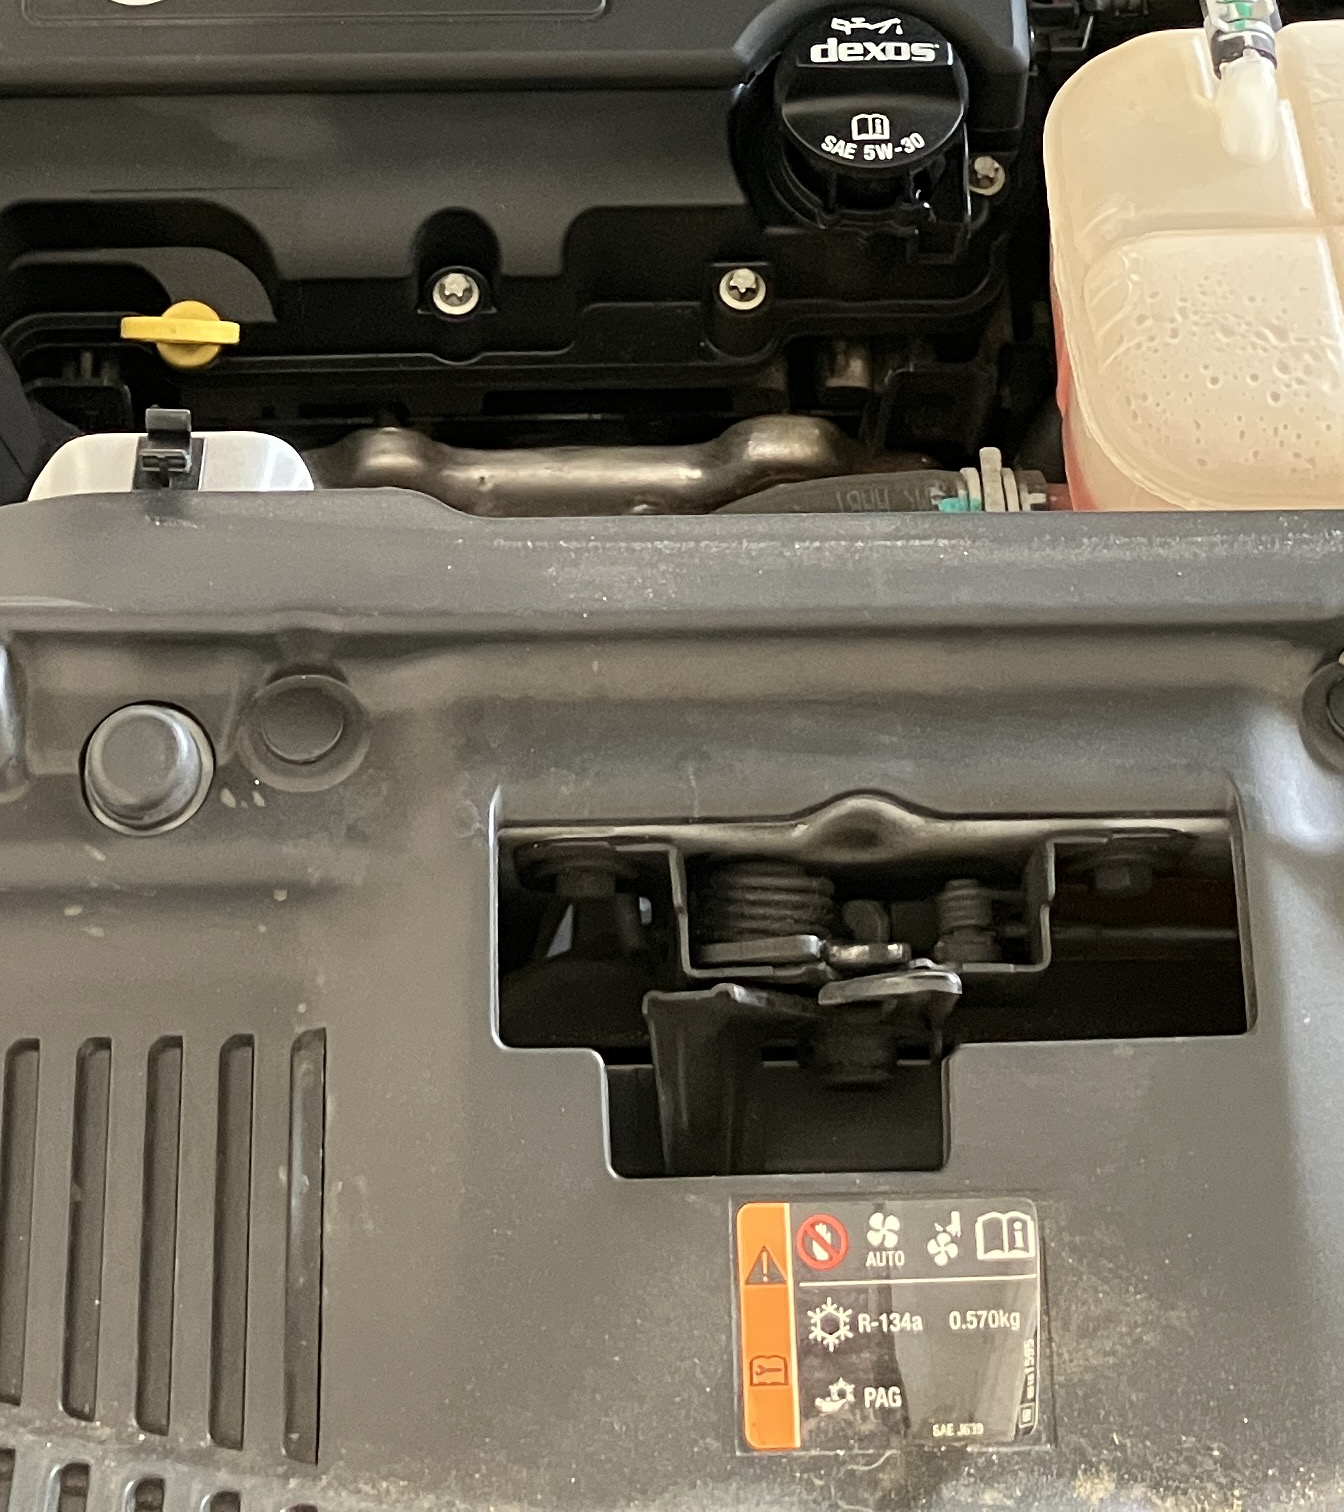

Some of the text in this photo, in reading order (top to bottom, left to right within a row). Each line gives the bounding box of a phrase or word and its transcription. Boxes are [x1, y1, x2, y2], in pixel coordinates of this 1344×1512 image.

[810, 37, 939, 63] dexos
[820, 131, 926, 161] SAE 5W-30
[865, 1250, 905, 1267] AUTO
[857, 1309, 1021, 1335] R-134a 0.570kg
[863, 1386, 903, 1408] PAG
[932, 1422, 954, 1437] SAE
